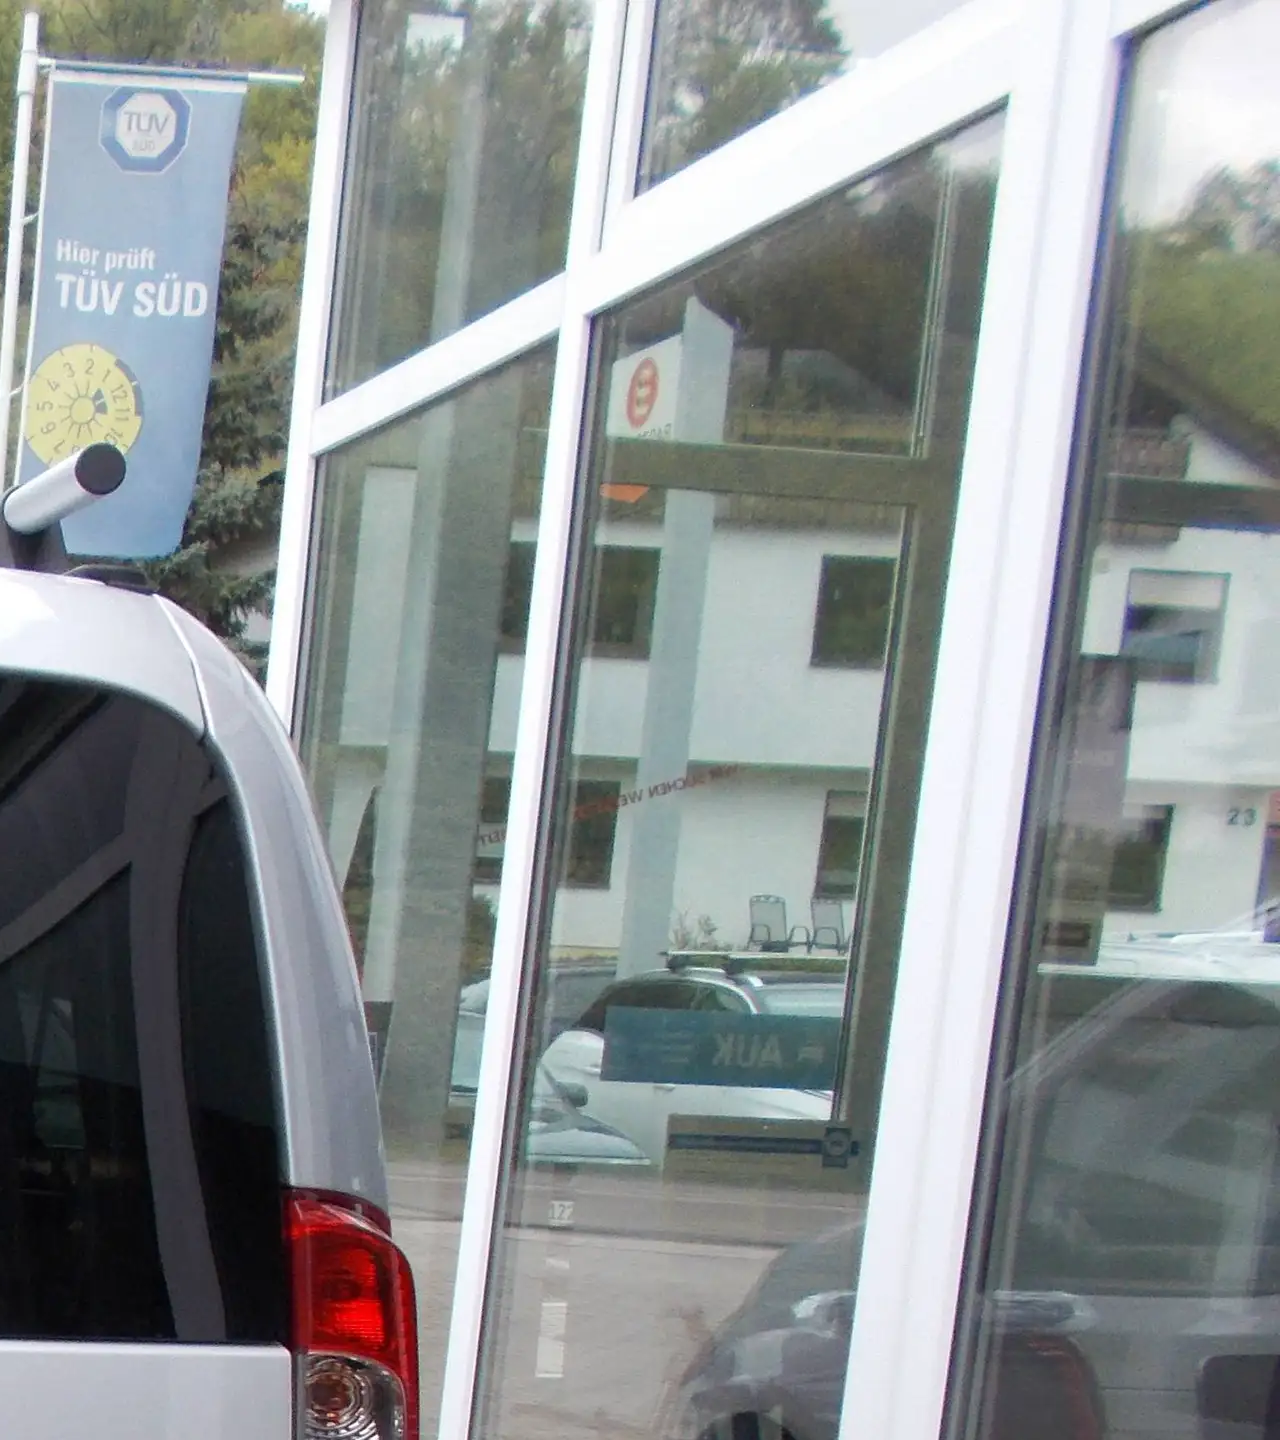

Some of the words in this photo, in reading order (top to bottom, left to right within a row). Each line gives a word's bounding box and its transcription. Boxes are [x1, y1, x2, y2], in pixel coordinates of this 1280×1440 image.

[56, 239, 100, 265] Hier
[104, 247, 156, 273] prüft
[55, 269, 124, 315] TÜV
[133, 272, 208, 317] SÜD
